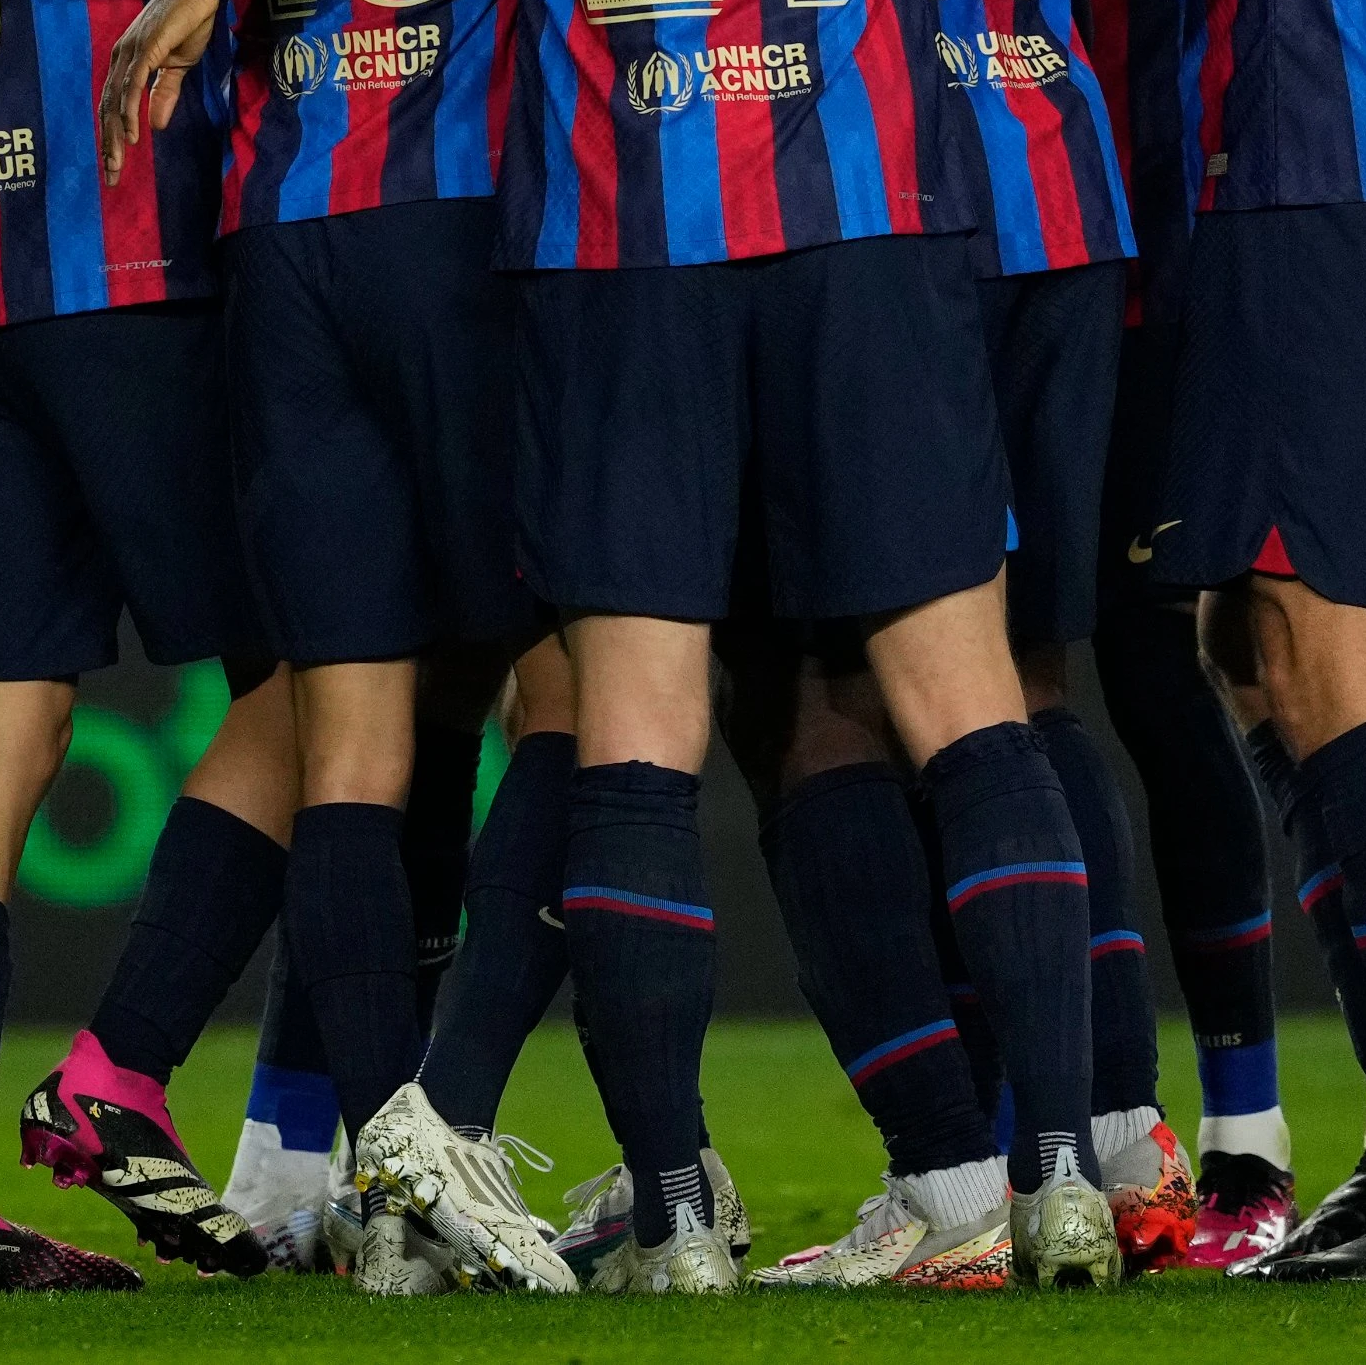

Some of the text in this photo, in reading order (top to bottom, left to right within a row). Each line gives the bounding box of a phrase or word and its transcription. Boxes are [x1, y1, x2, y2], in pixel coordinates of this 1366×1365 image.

[331, 24, 441, 56] UNHCR
[333, 49, 439, 81] ACNUR
[694, 42, 808, 73] UNHCR
[986, 52, 1067, 80] ACNUR
[335, 83, 351, 92] The
[352, 81, 366, 91] UN
[368, 79, 406, 91] Refugee
[700, 64, 812, 94] ACNUR
[989, 81, 1007, 90] The
[701, 86, 812, 103] The UN Refugee Agency
[4, 179, 36, 191] Agency
